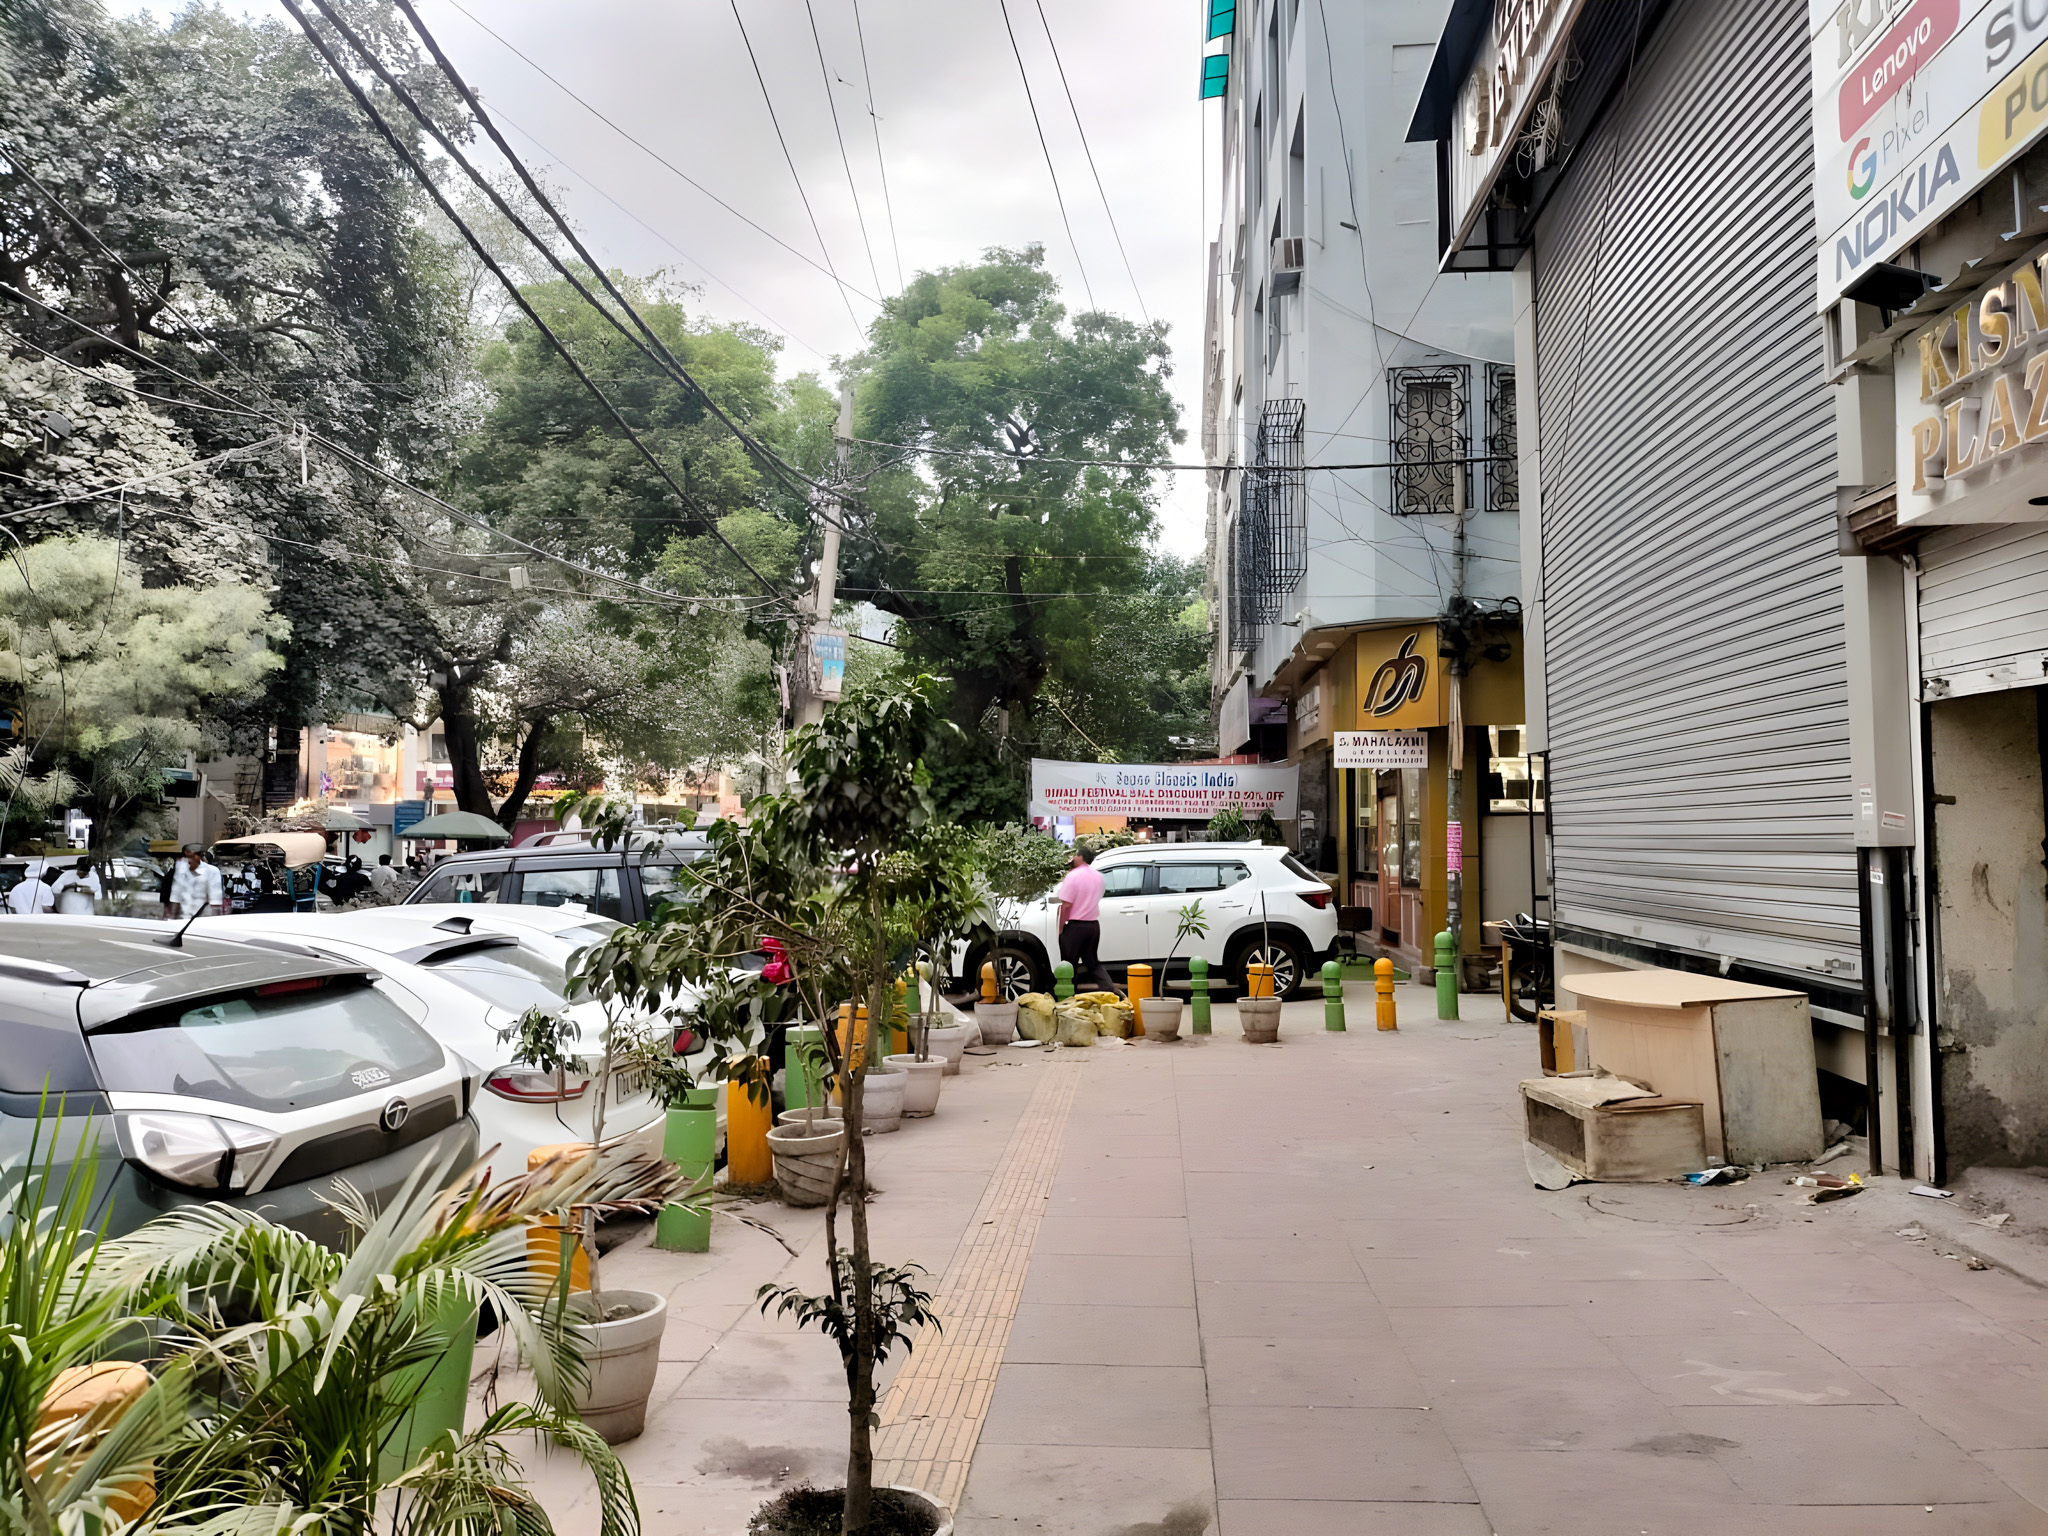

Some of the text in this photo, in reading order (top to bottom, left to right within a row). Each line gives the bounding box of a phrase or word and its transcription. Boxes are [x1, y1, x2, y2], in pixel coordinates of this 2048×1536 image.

[1861, 16, 1932, 106] Lenovo
[1882, 92, 1930, 166] Pixel
[1836, 142, 1960, 283] NOKIA
[1158, 789, 1208, 799] DISCOUNT
[1211, 790, 1225, 799] UP
[1228, 791, 1240, 800] TO
[1266, 791, 1284, 801] OFF
